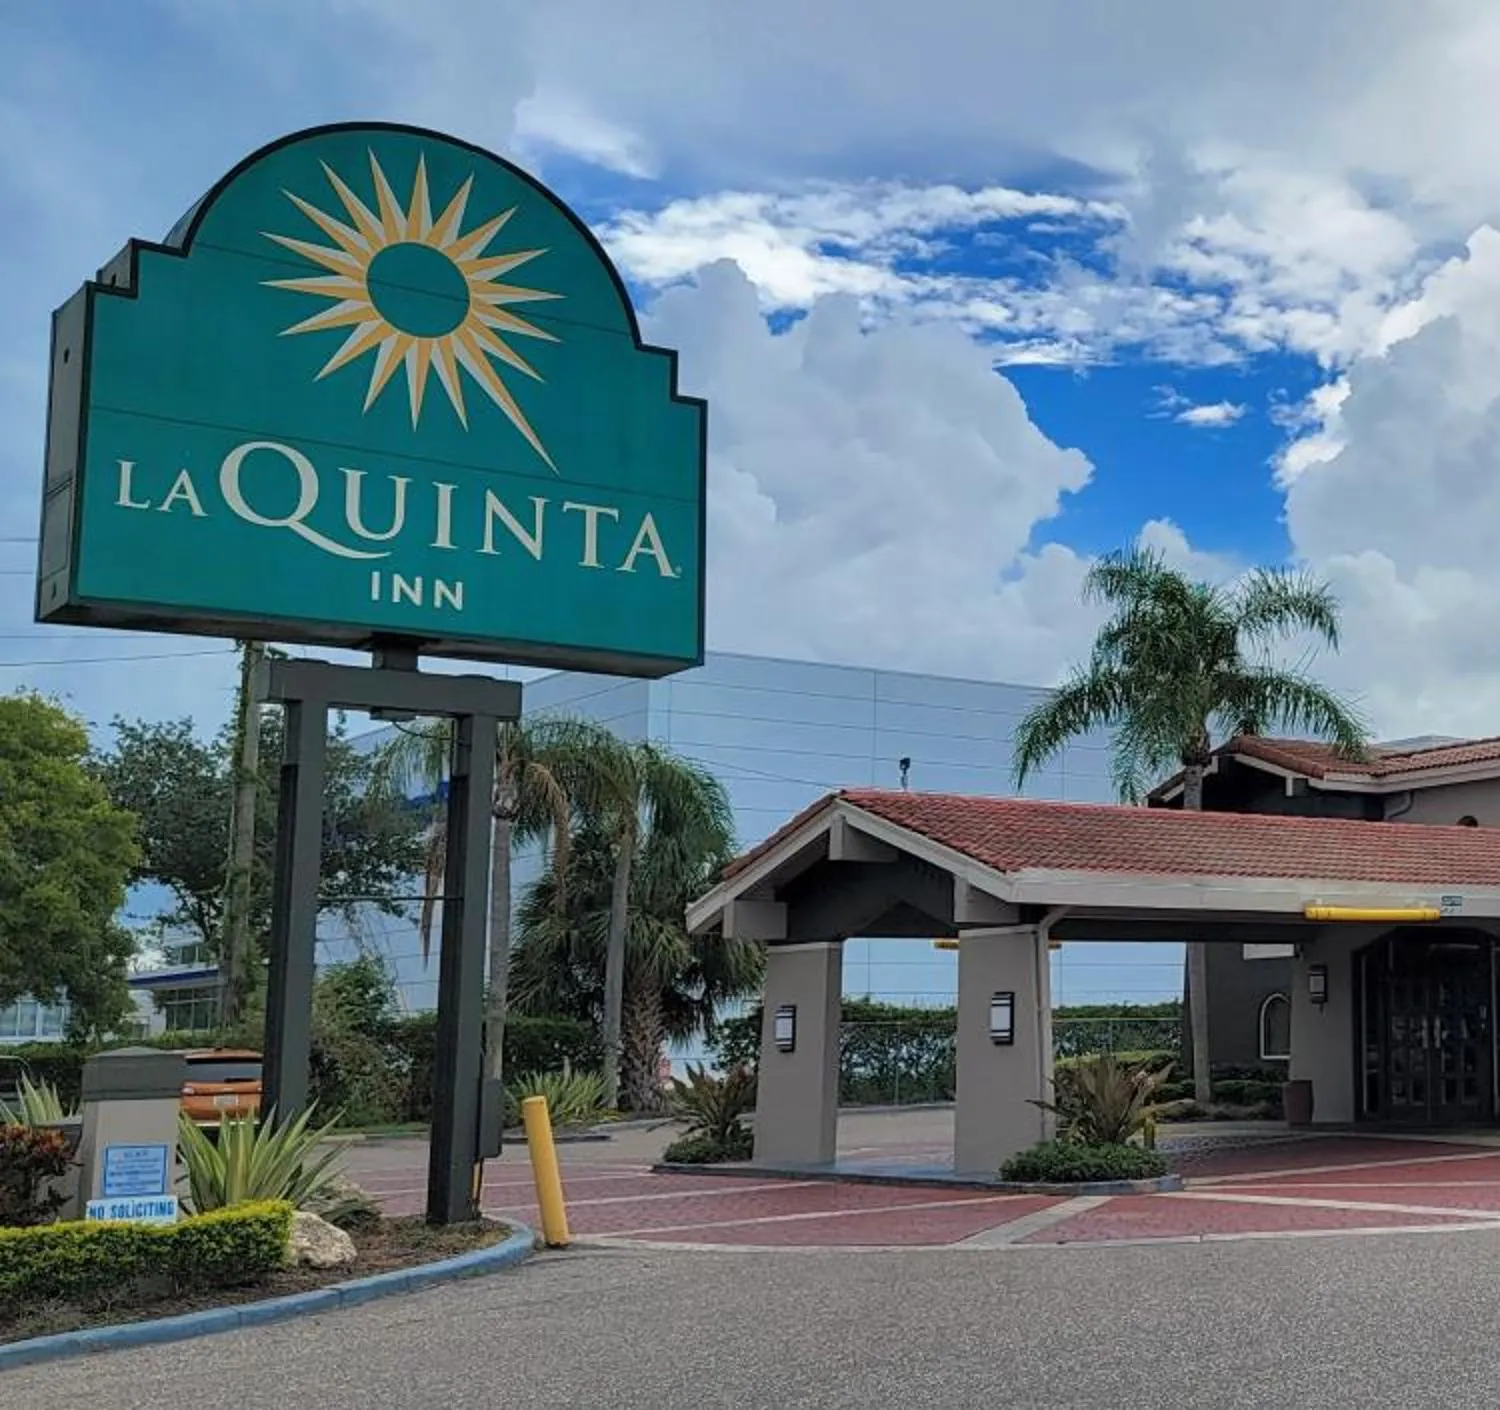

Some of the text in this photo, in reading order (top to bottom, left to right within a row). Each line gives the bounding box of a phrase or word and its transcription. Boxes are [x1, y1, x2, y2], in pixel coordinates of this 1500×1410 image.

[115, 441, 679, 577] LA QUINTA
[371, 570, 463, 611] INN
[89, 1201, 174, 1219] NO SOLICITING
